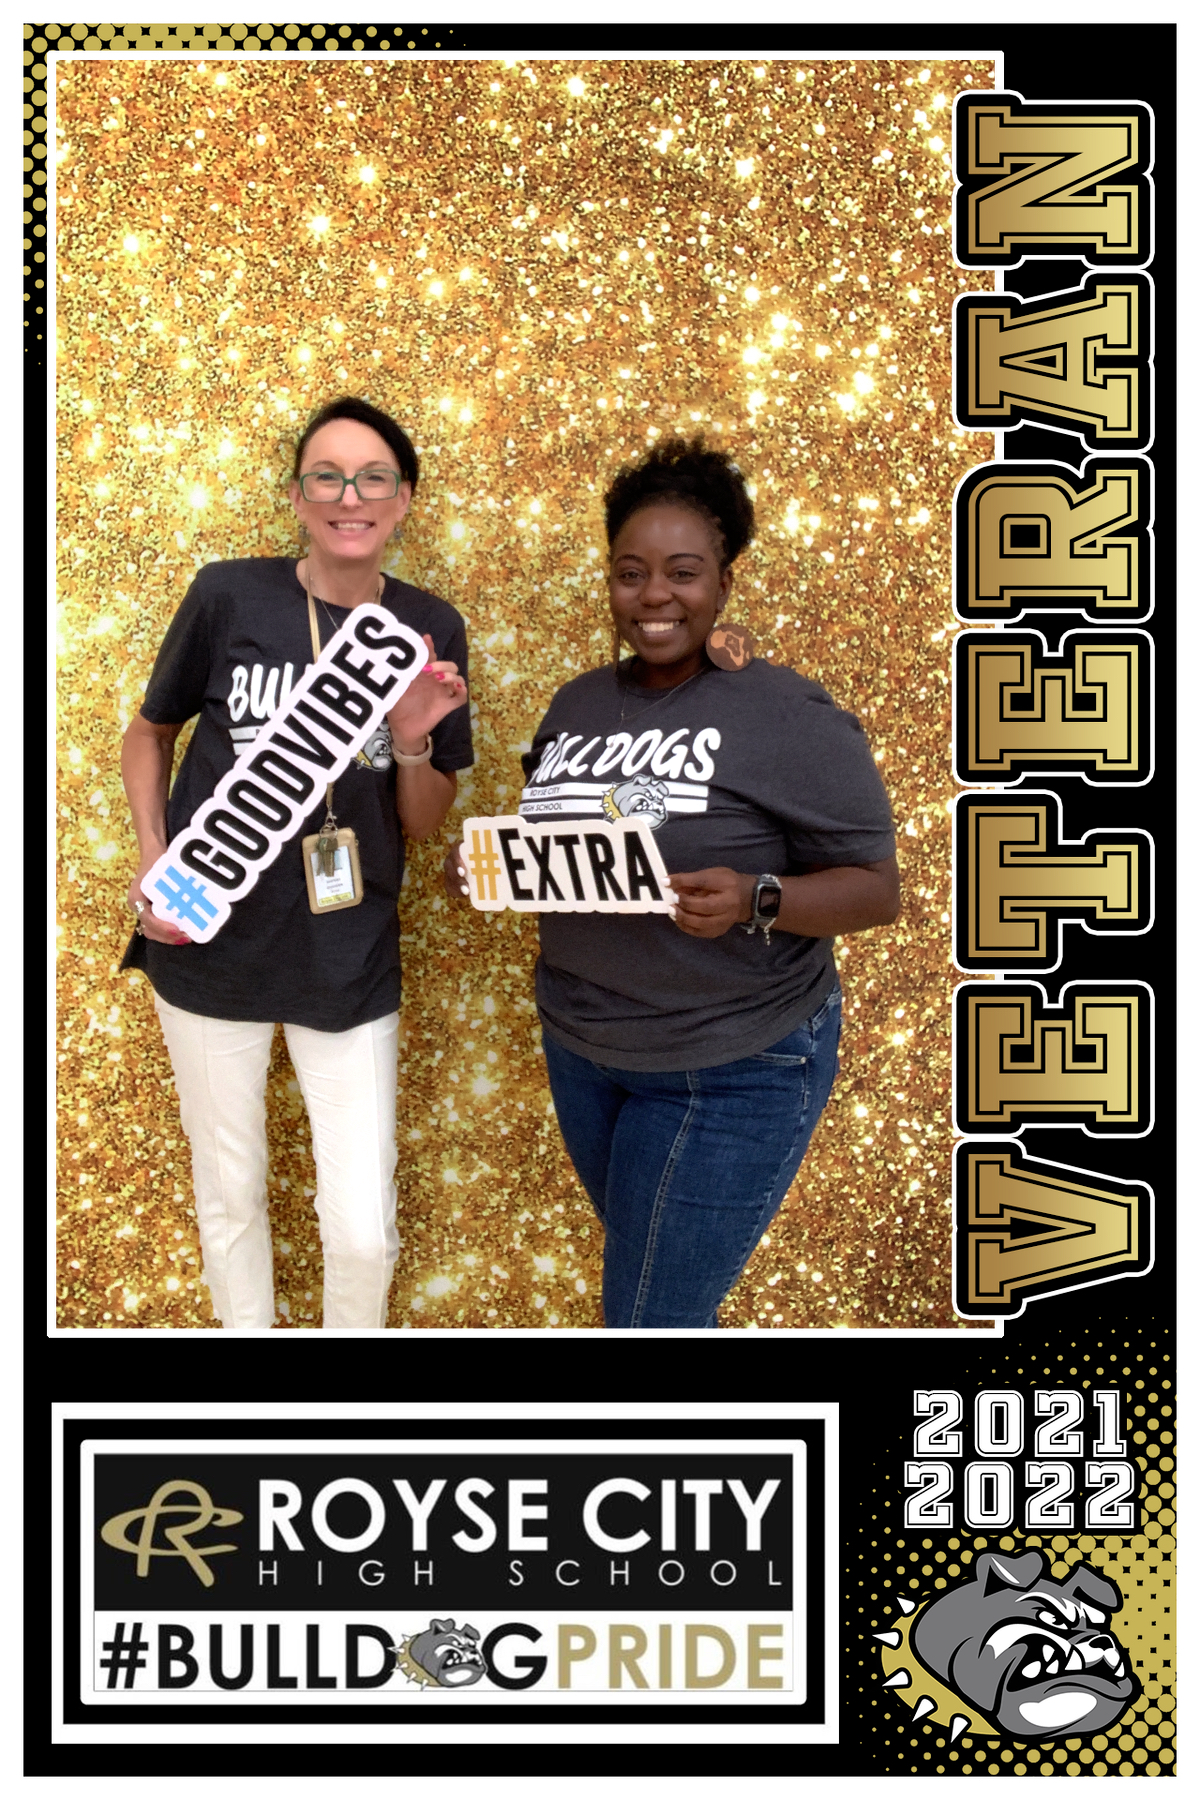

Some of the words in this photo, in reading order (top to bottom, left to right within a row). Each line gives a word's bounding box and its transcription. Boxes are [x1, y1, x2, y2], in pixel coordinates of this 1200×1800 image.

[155, 615, 417, 932] #GOODVIBES
[529, 788, 547, 797] ROYSE
[548, 786, 561, 795] CITY
[522, 804, 535, 812] HIGH
[535, 803, 563, 812] SCHOOL
[469, 827, 662, 901] #EXTRA
